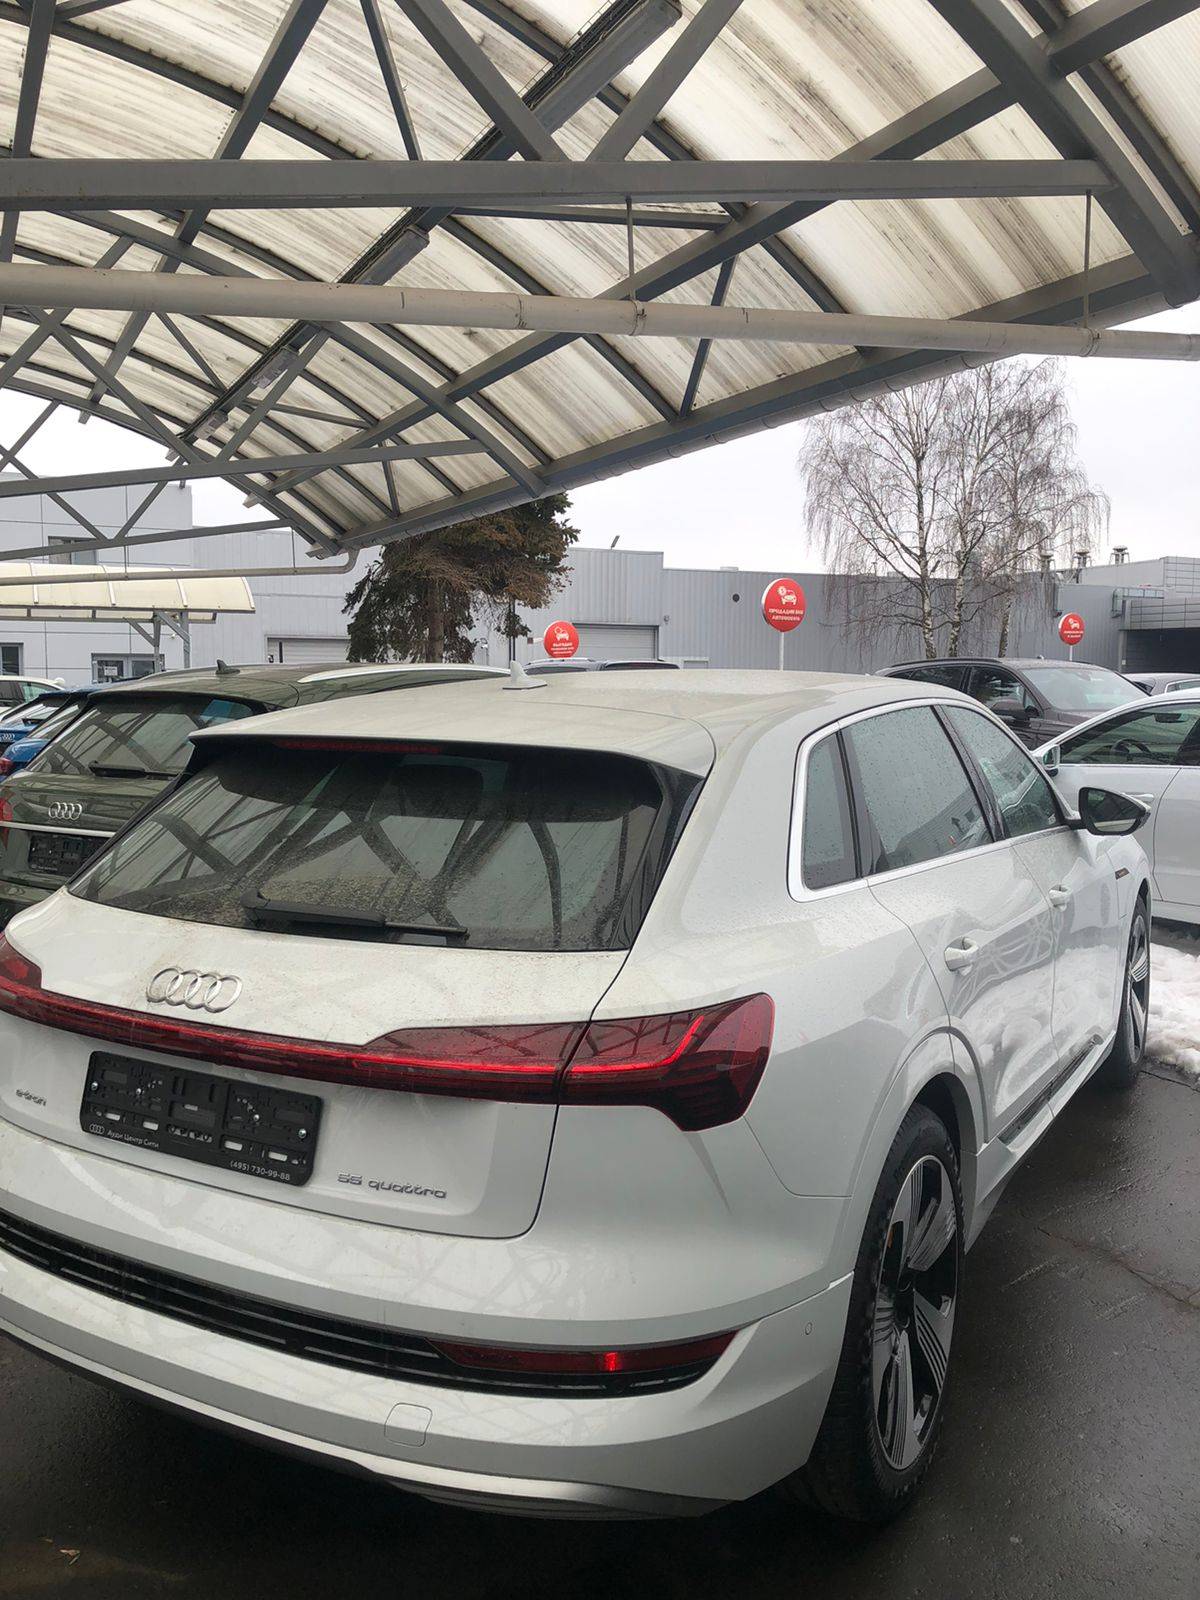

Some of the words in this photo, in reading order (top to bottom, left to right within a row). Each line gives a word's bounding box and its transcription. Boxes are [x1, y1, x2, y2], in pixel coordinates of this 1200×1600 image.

[107, 1129, 123, 1139] Ауди
[123, 1133, 143, 1145] Центр
[143, 1138, 159, 1148] Сити
[230, 1160, 250, 1171] (495)
[251, 1165, 291, 1181] 730-99-88
[337, 1173, 362, 1186] 55
[368, 1180, 448, 1199] quattro
